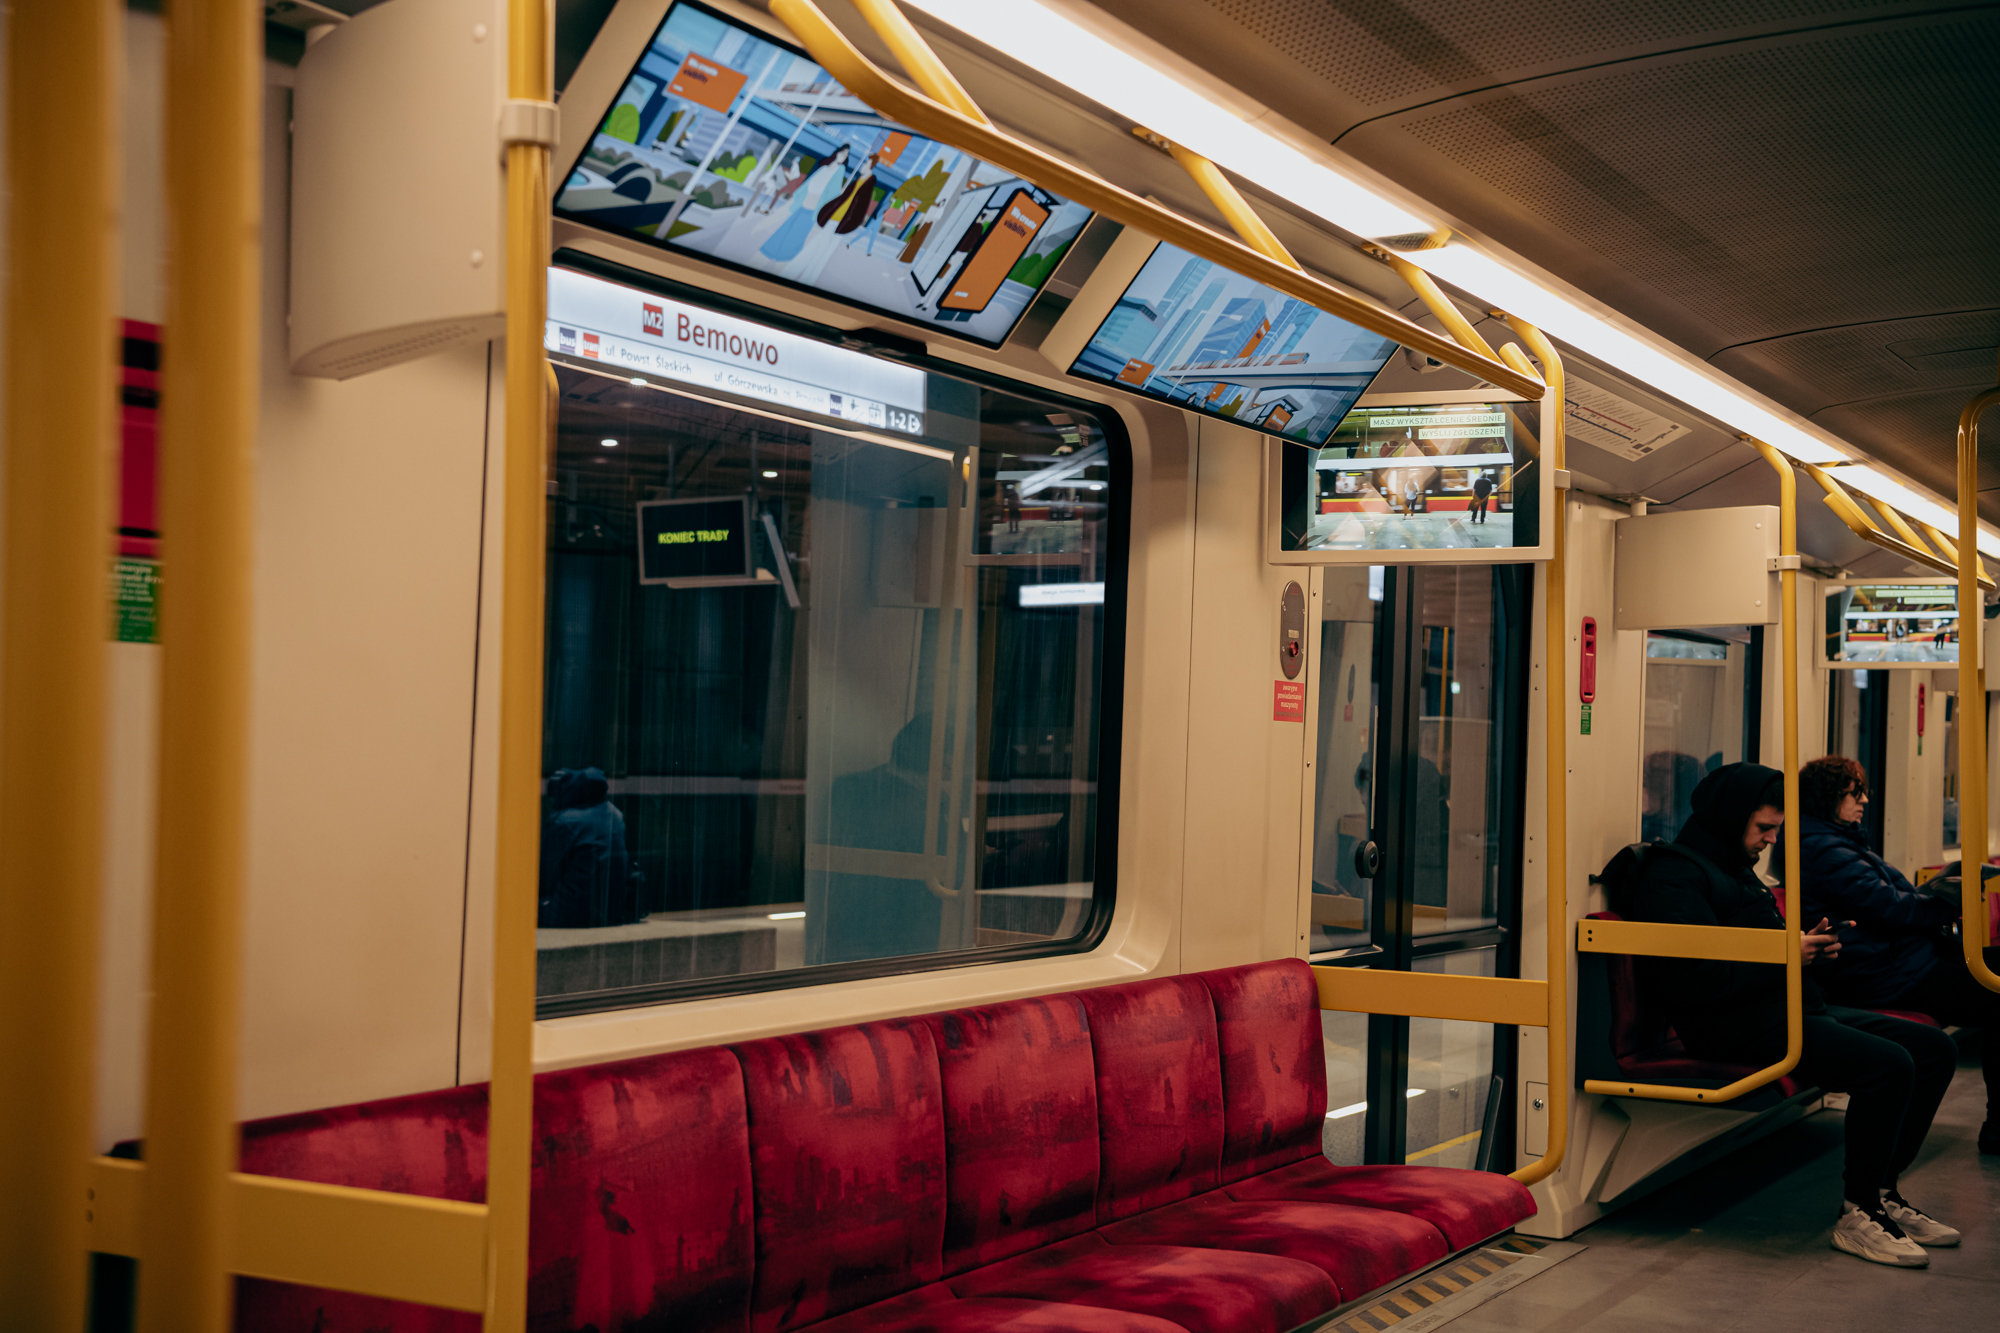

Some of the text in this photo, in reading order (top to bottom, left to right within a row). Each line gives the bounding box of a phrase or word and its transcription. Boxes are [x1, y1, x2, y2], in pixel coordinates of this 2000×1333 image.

[560, 331, 576, 347] bus
[583, 339, 599, 353] tram
[643, 309, 778, 365] M2 Bemowo
[889, 410, 907, 431] 1-2
[1373, 413, 1503, 426] MASZ WYKSZTAŁCENIE ŚREDNIE
[1421, 426, 1504, 438] WYŚLIJ ZGŁOSZENIE
[658, 529, 730, 544] KONIEC TRASY
